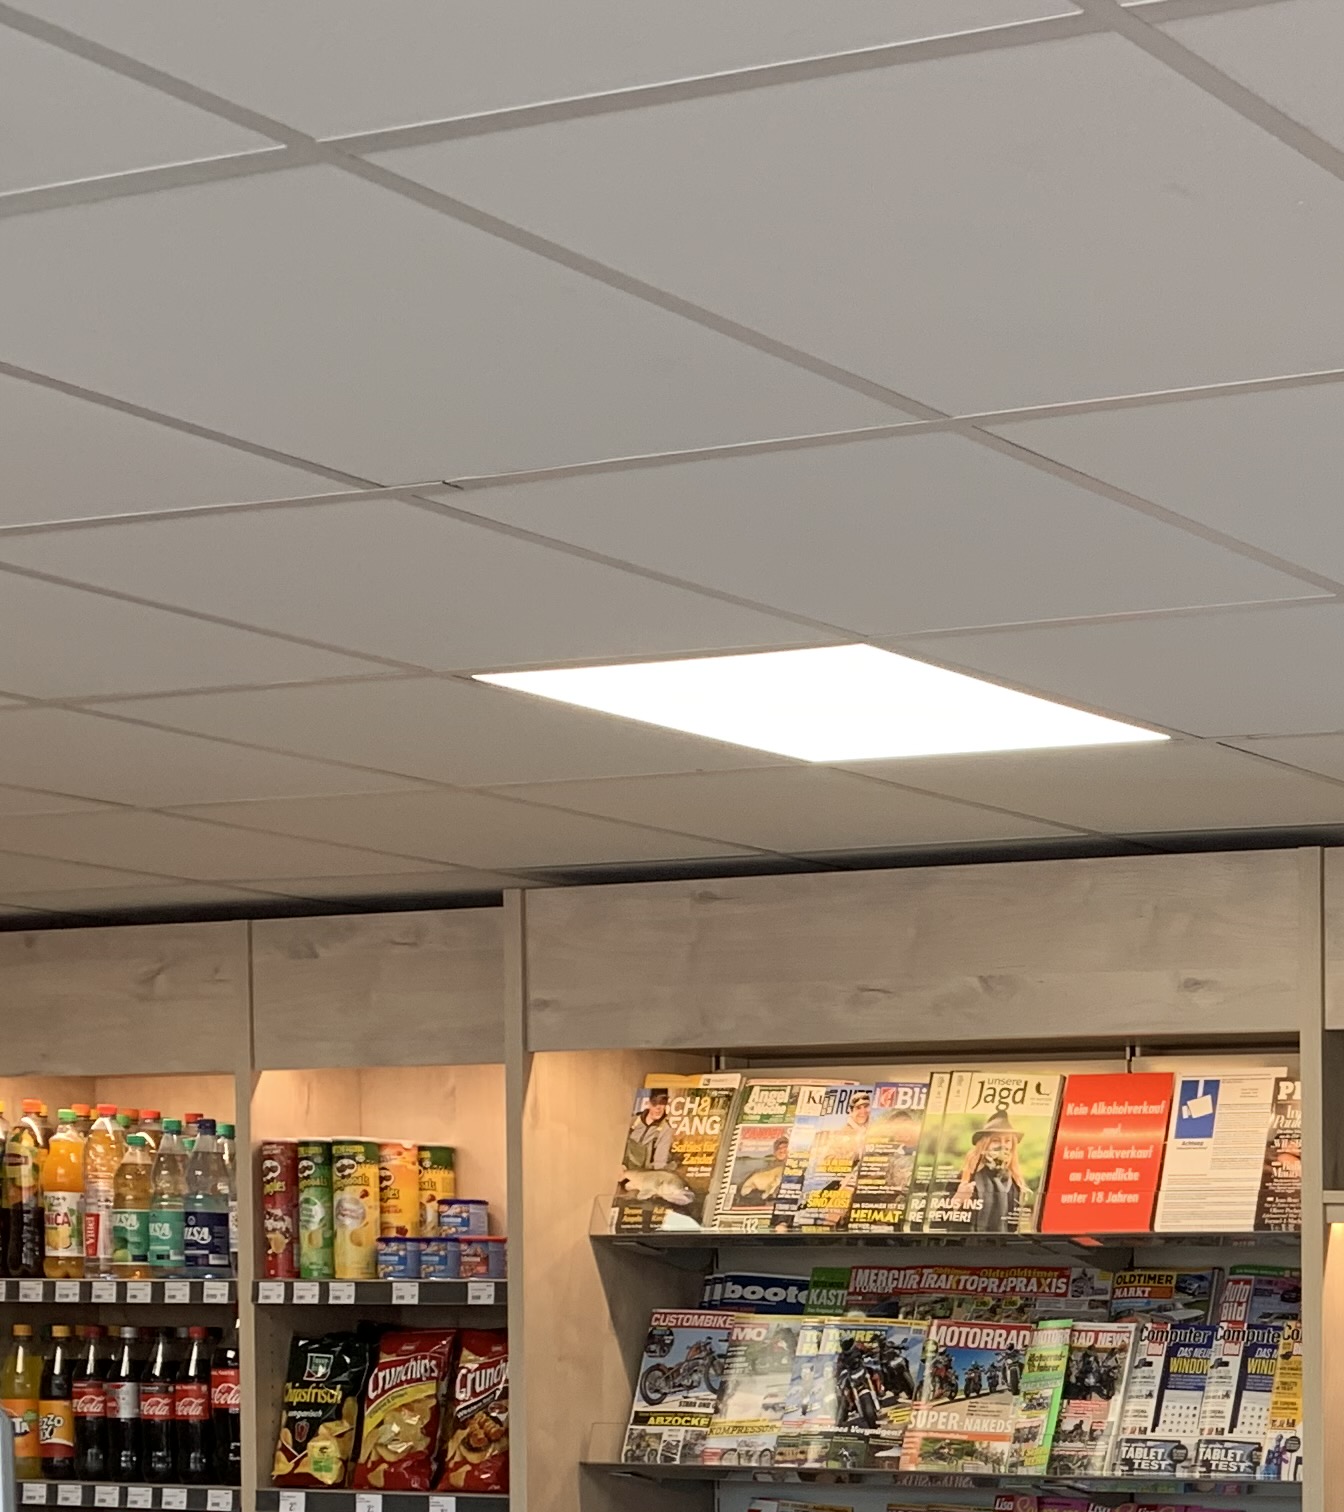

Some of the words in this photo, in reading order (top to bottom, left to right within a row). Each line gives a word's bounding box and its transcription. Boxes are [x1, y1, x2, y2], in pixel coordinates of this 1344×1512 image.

[987, 1078, 1022, 1087] unsere
[971, 1080, 1028, 1112] Jagd
[1067, 1103, 1089, 1116] Kein
[1091, 1101, 1165, 1116] Alkoholverkauf
[1063, 1147, 1085, 1160] kein
[1087, 1145, 1153, 1160] Tabakverkauf
[1069, 1172, 1081, 1182] an
[1083, 1167, 1139, 1184] Jugendliche
[931, 1198, 961, 1210] RAUS
[963, 1199, 984, 1211] INS
[1061, 1192, 1087, 1204] unter
[1091, 1191, 1103, 1203] 18
[1106, 1190, 1139, 1205] Jahren
[928, 1211, 971, 1222] REVIER!
[1006, 1278, 1067, 1293] PRAXIS
[1116, 1275, 1173, 1285] OLDTIMER
[1115, 1288, 1150, 1298] MARKT
[651, 1313, 735, 1327] CUSTOMBIKE
[931, 1326, 1031, 1349] MOTORRAD
[1098, 1332, 1130, 1347] NEWS
[1141, 1325, 1211, 1345] Computer
[369, 1359, 439, 1398] Crunchips
[648, 1416, 709, 1427] ABZOCKE
[908, 1410, 1013, 1432] SUPER-NAKEDS
[1121, 1448, 1164, 1461] TABLET
[1199, 1448, 1241, 1461] TABLET
[1133, 1460, 1167, 1471] TEST
